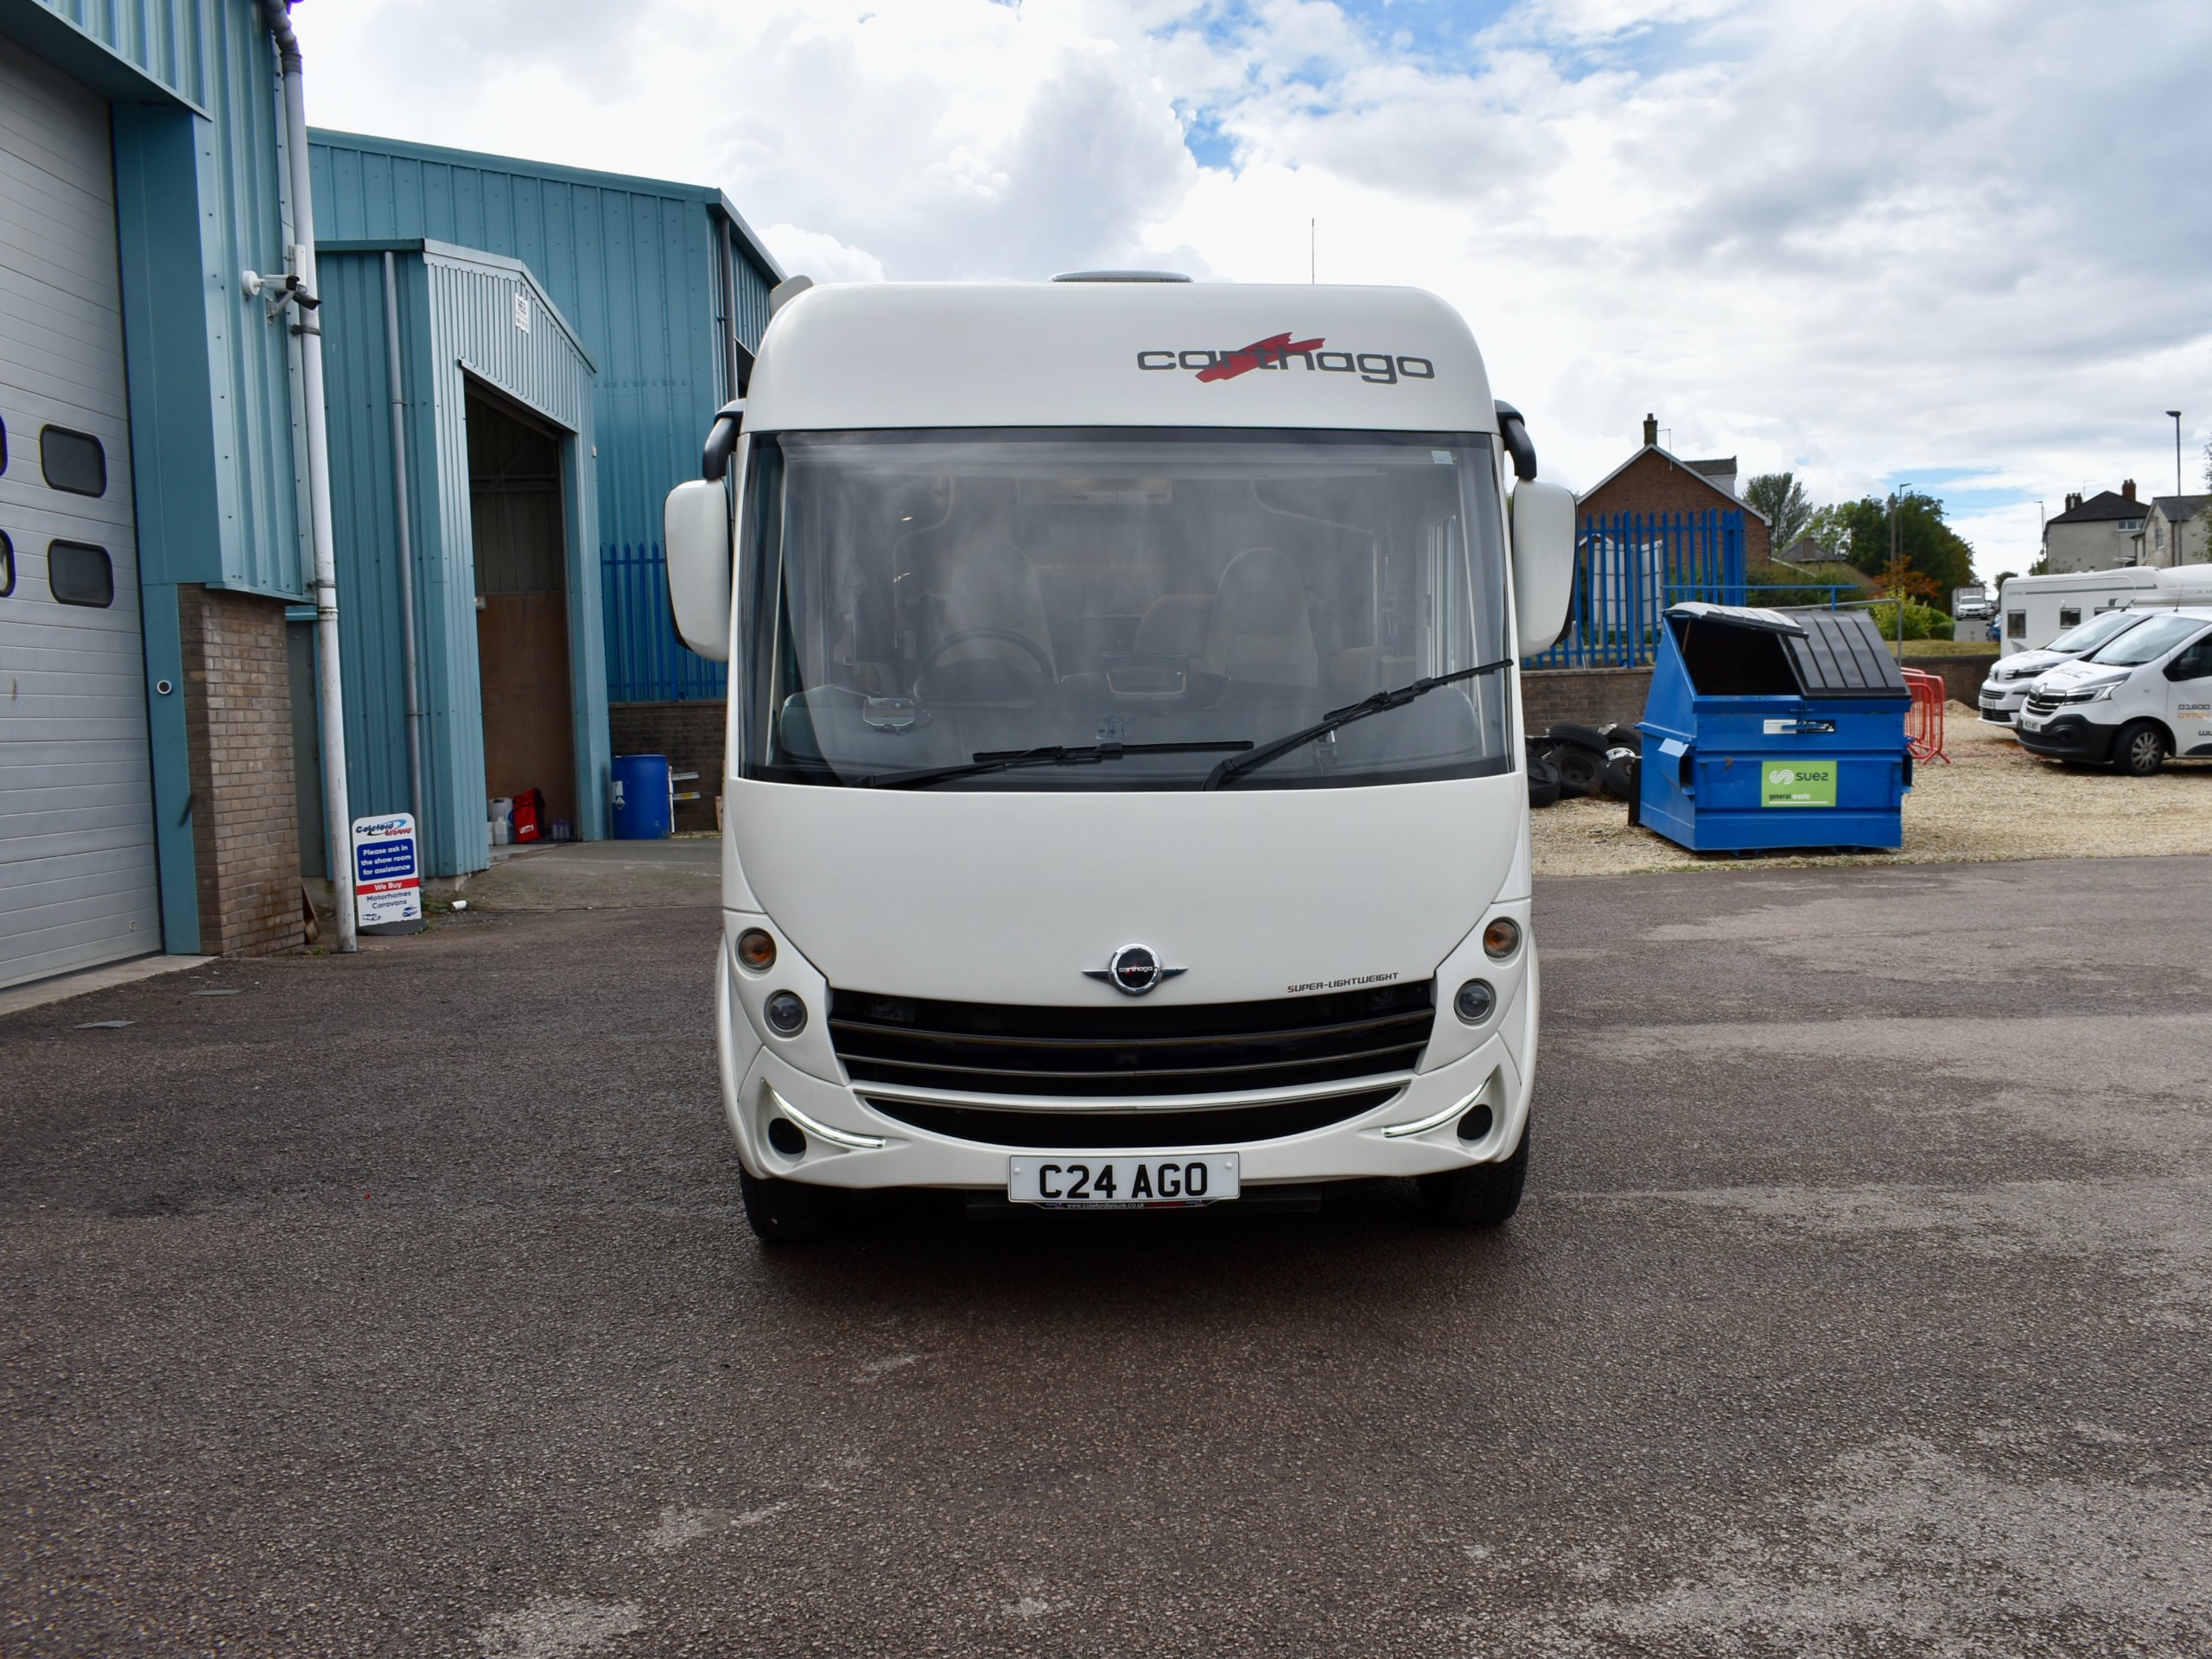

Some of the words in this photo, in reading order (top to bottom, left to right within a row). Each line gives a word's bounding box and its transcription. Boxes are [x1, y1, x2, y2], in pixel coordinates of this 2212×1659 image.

[1136, 345, 1435, 385] carthago
[1796, 772, 1828, 781] suez
[374, 864, 410, 874] assistance
[366, 892, 411, 901] Motorhomes
[372, 900, 407, 909] Caravans
[1287, 971, 1400, 994] SUPER-LIGHTWEIGHT
[1039, 1164, 1117, 1199] C24
[1130, 1161, 1208, 1199] AGO
